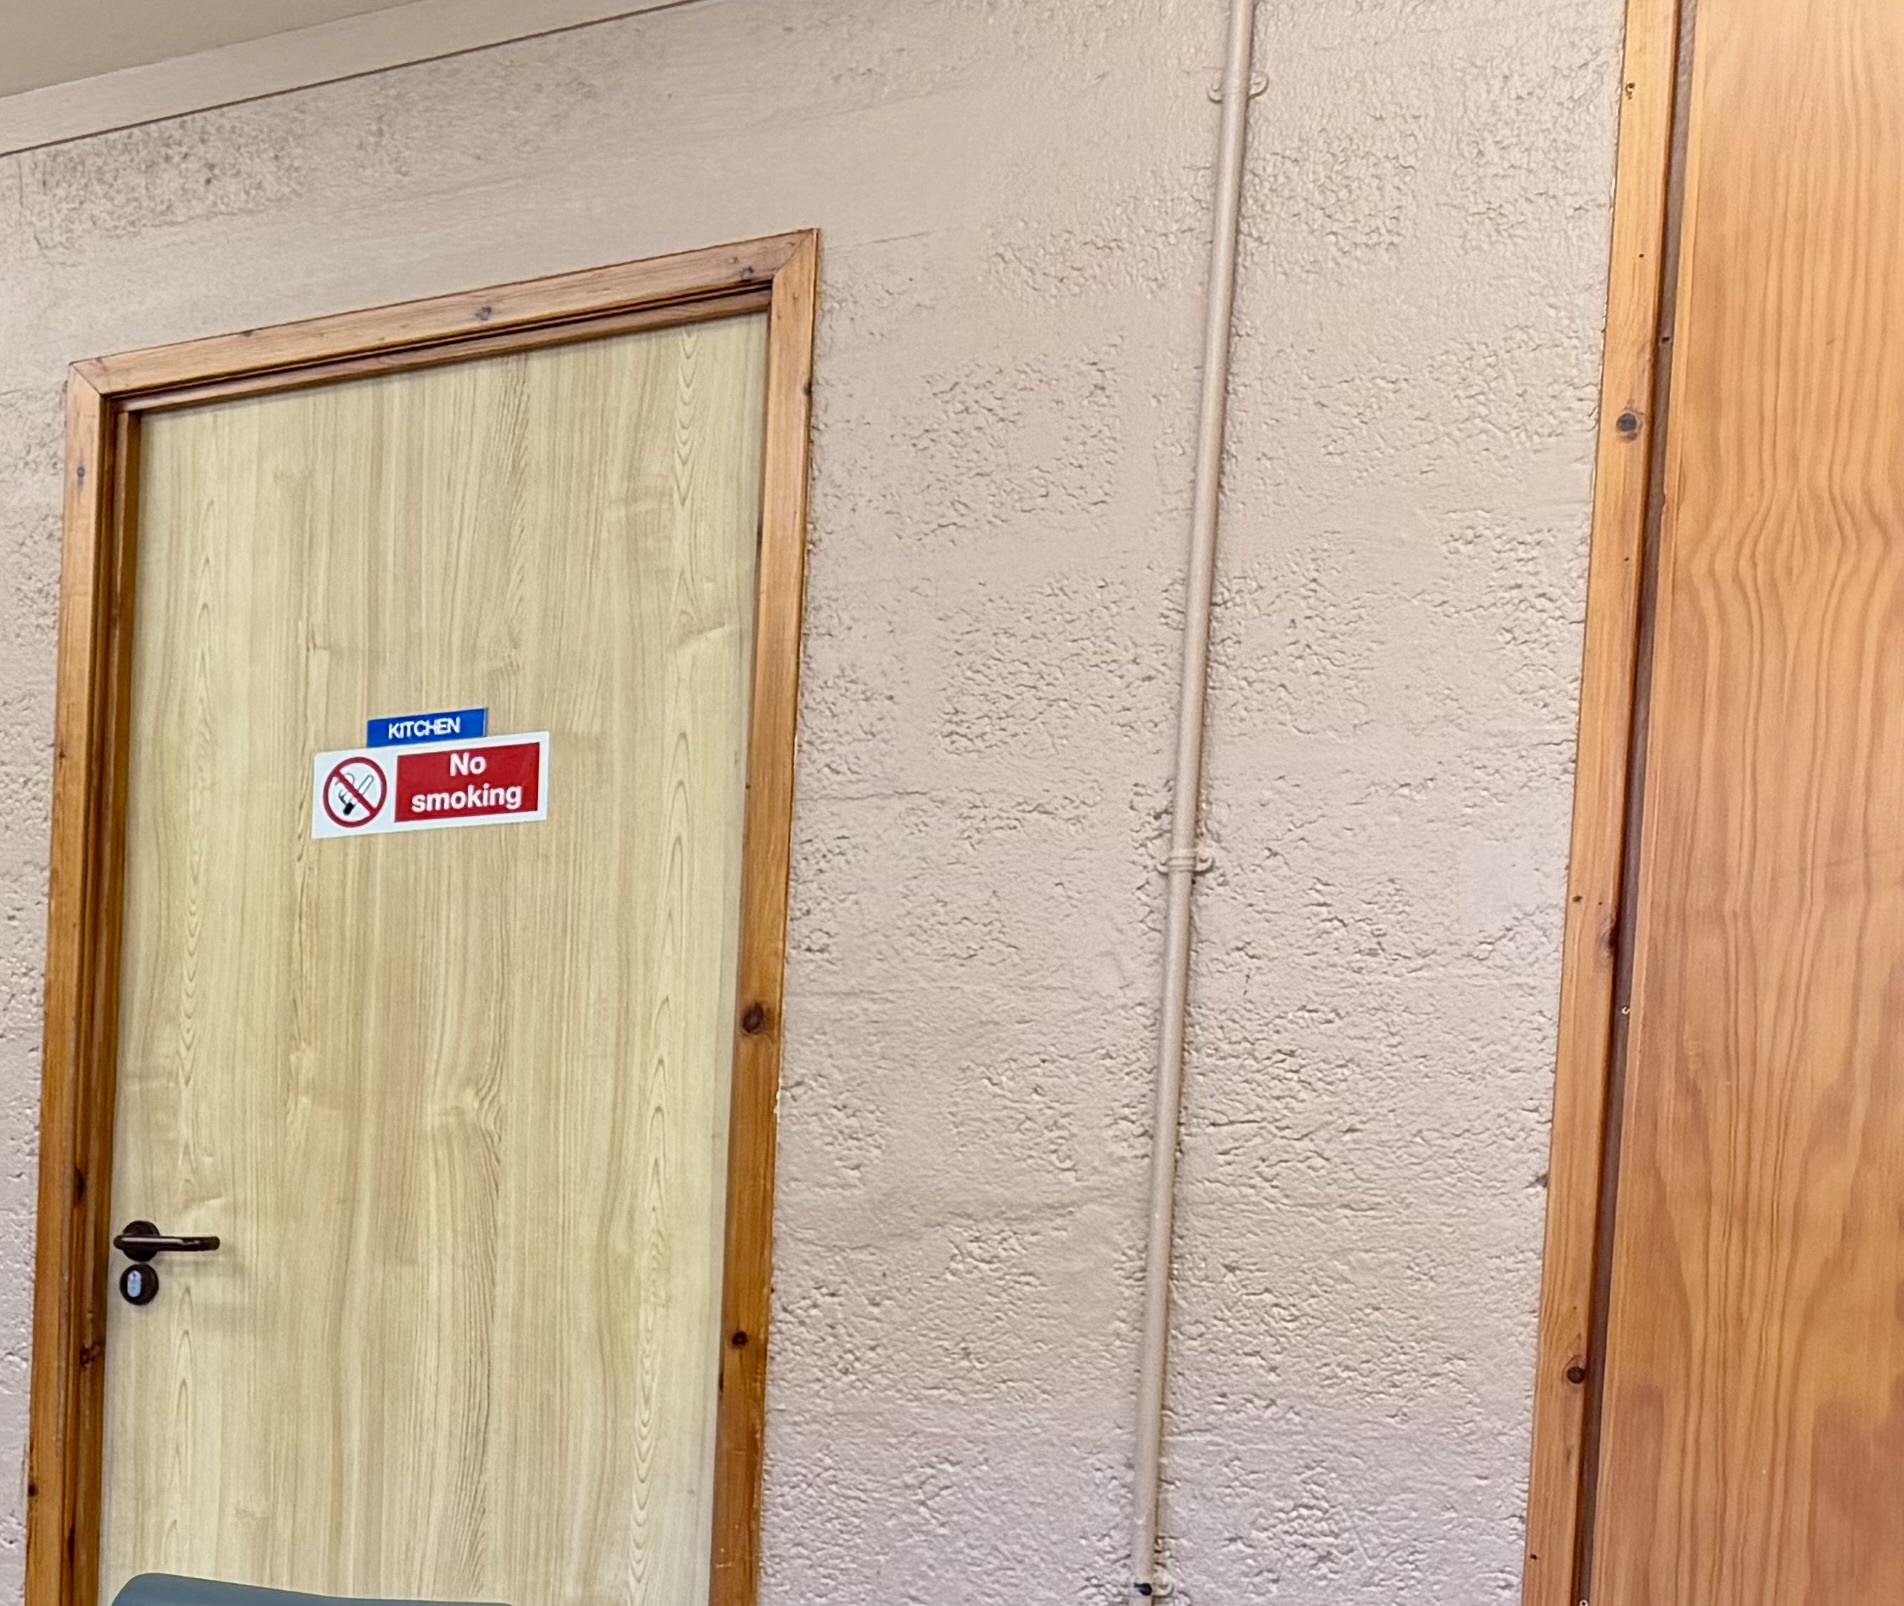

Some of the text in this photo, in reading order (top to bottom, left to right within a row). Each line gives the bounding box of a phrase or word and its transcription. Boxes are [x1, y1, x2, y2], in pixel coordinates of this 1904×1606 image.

[388, 716, 461, 740] KITCHEN
[449, 752, 487, 777] No
[411, 783, 522, 812] smoking
